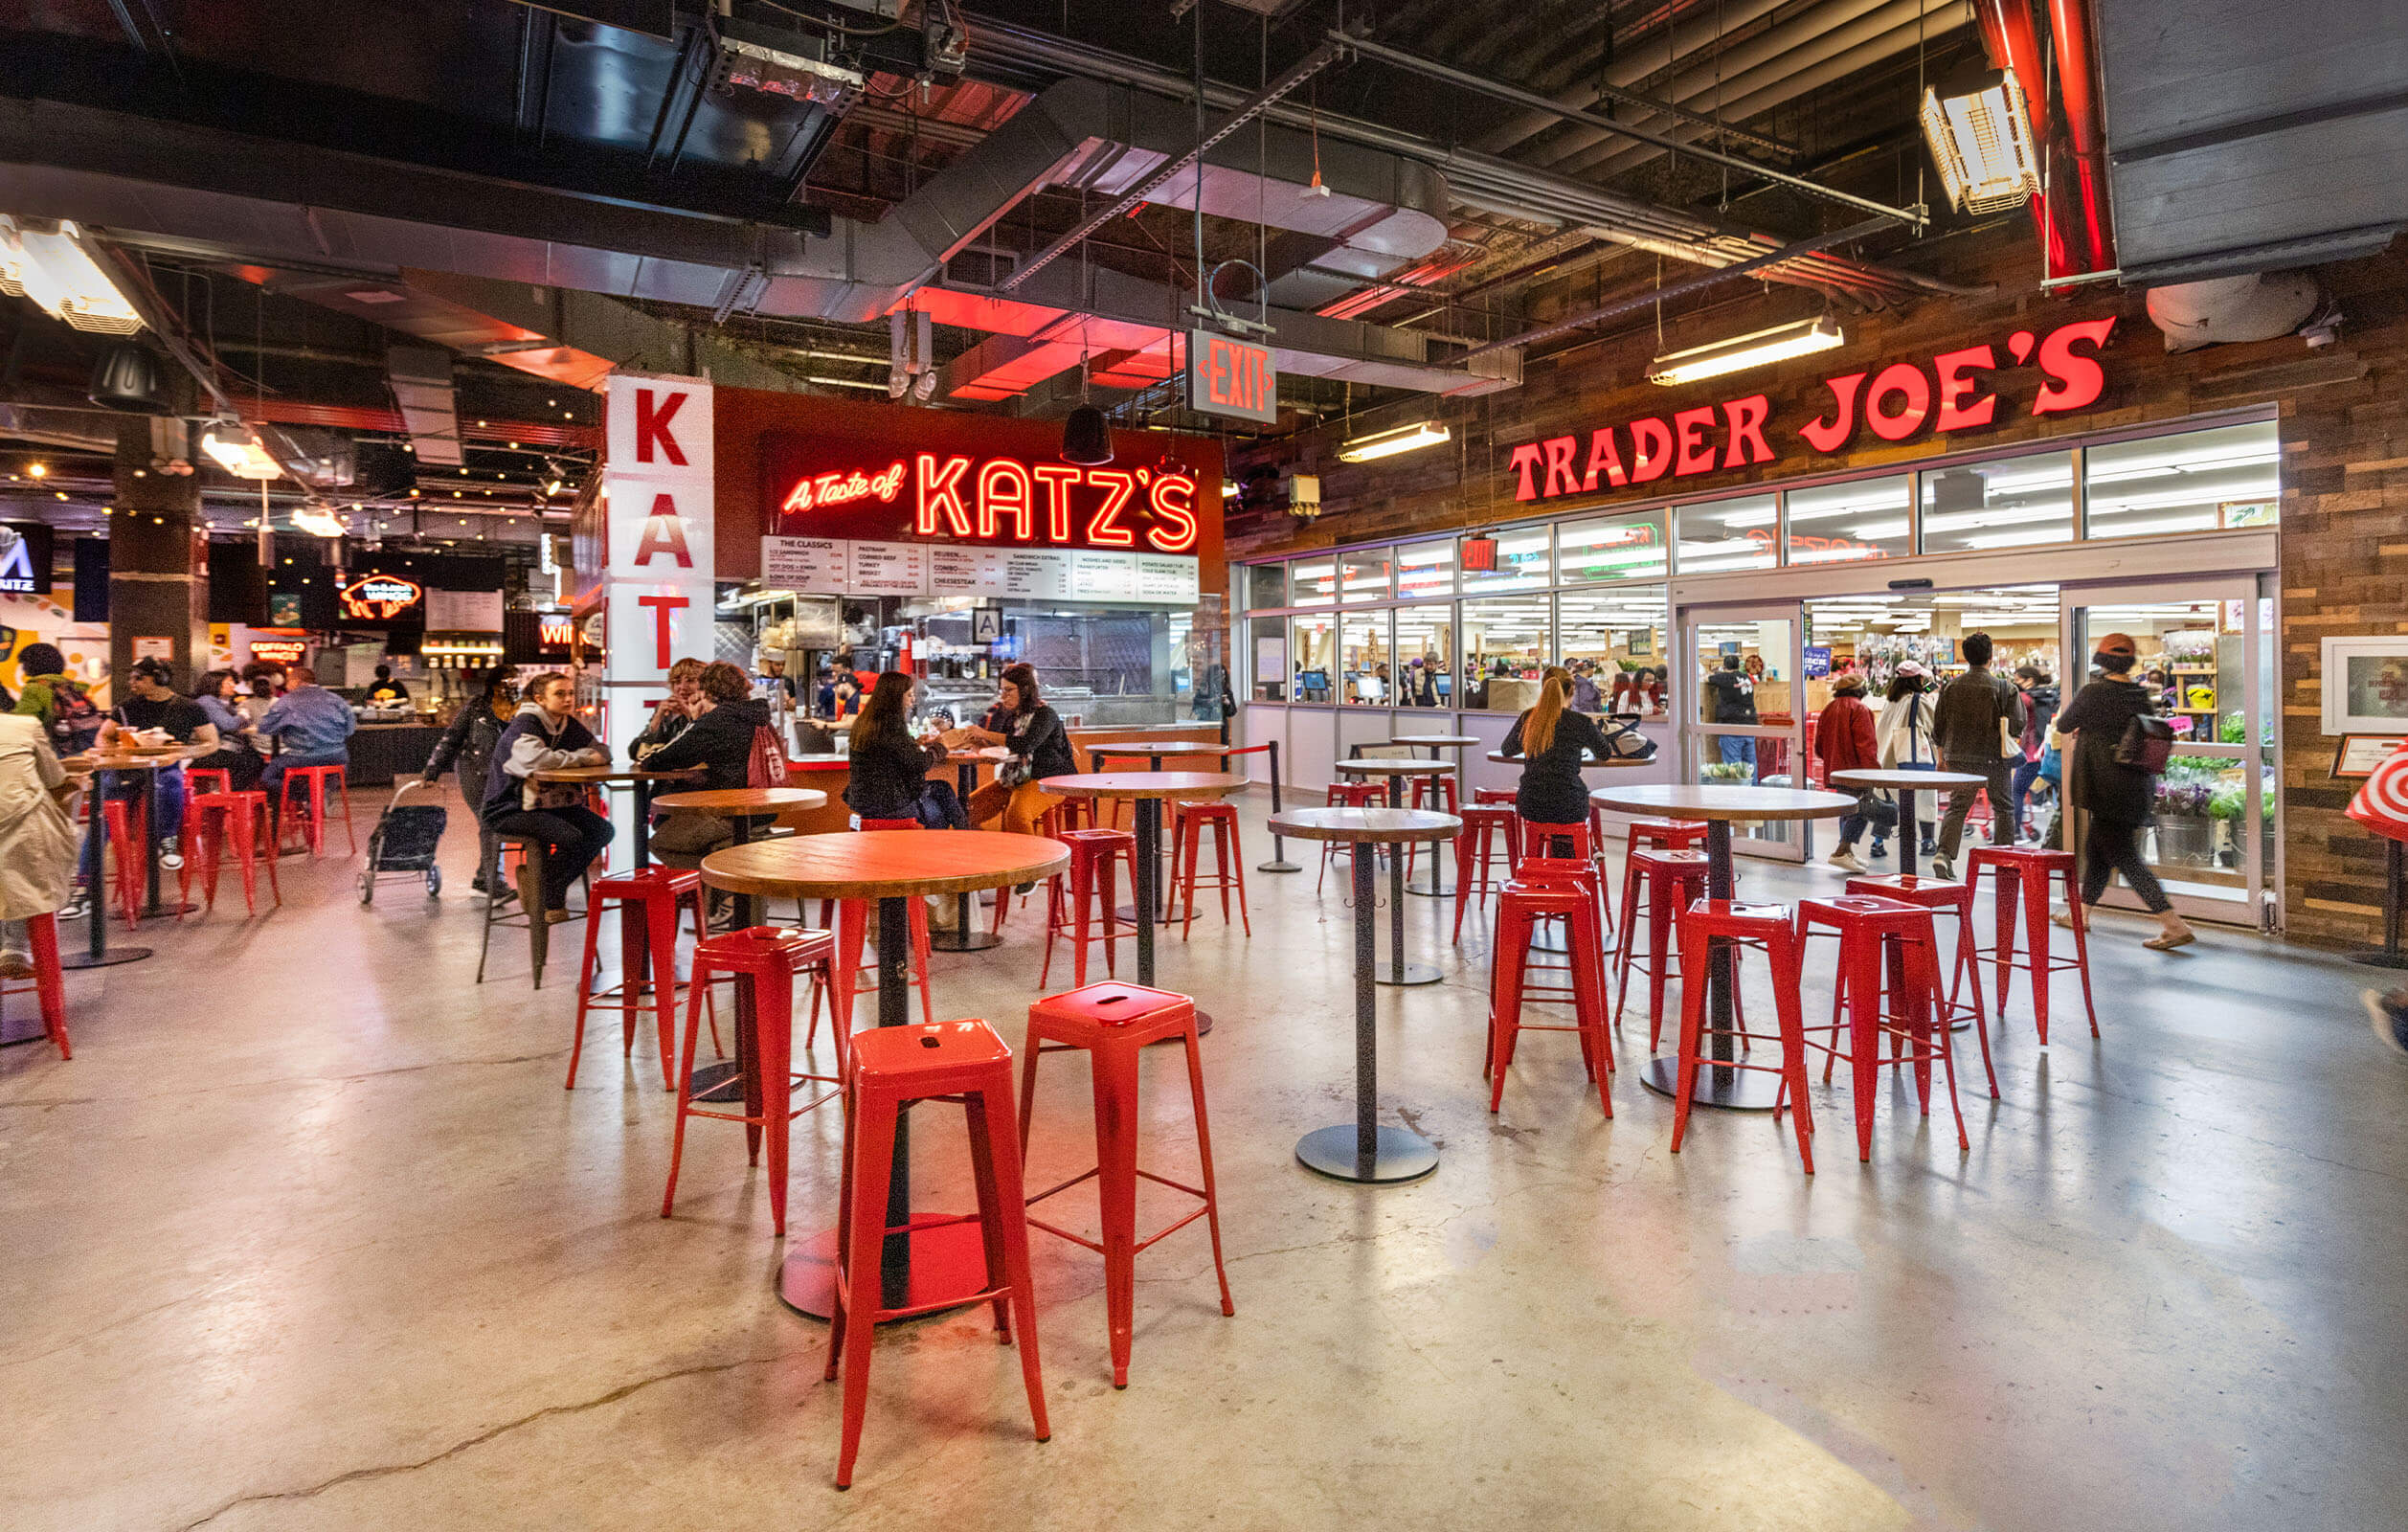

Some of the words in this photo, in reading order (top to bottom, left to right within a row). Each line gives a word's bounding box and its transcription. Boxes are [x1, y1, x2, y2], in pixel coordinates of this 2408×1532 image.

[1209, 338, 1268, 412] EXIT
[1508, 394, 1776, 502] TRADER
[1799, 315, 2117, 452] JOE'S
[782, 482, 813, 513] A
[815, 472, 867, 508] Taste
[870, 461, 907, 501] of
[915, 451, 1199, 552] KATZ'S
[797, 540, 833, 550] CLASSICS
[1464, 539, 1492, 568] EXIT
